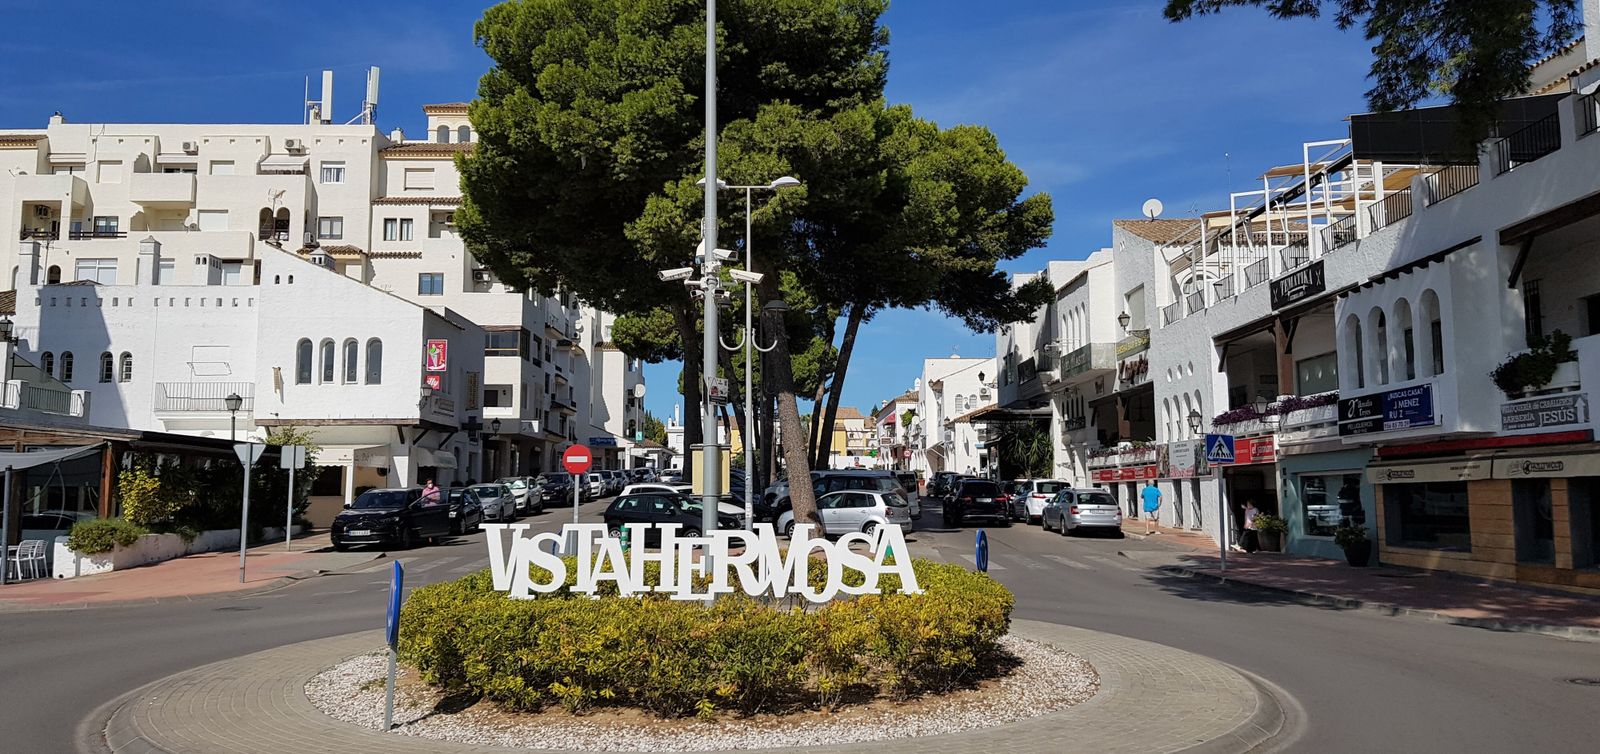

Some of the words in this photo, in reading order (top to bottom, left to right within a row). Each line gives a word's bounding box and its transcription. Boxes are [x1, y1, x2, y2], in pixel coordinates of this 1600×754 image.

[1393, 398, 1420, 409] JMENEZ
[1389, 410, 1403, 419] RUZ
[1539, 407, 1574, 427] JESÚS
